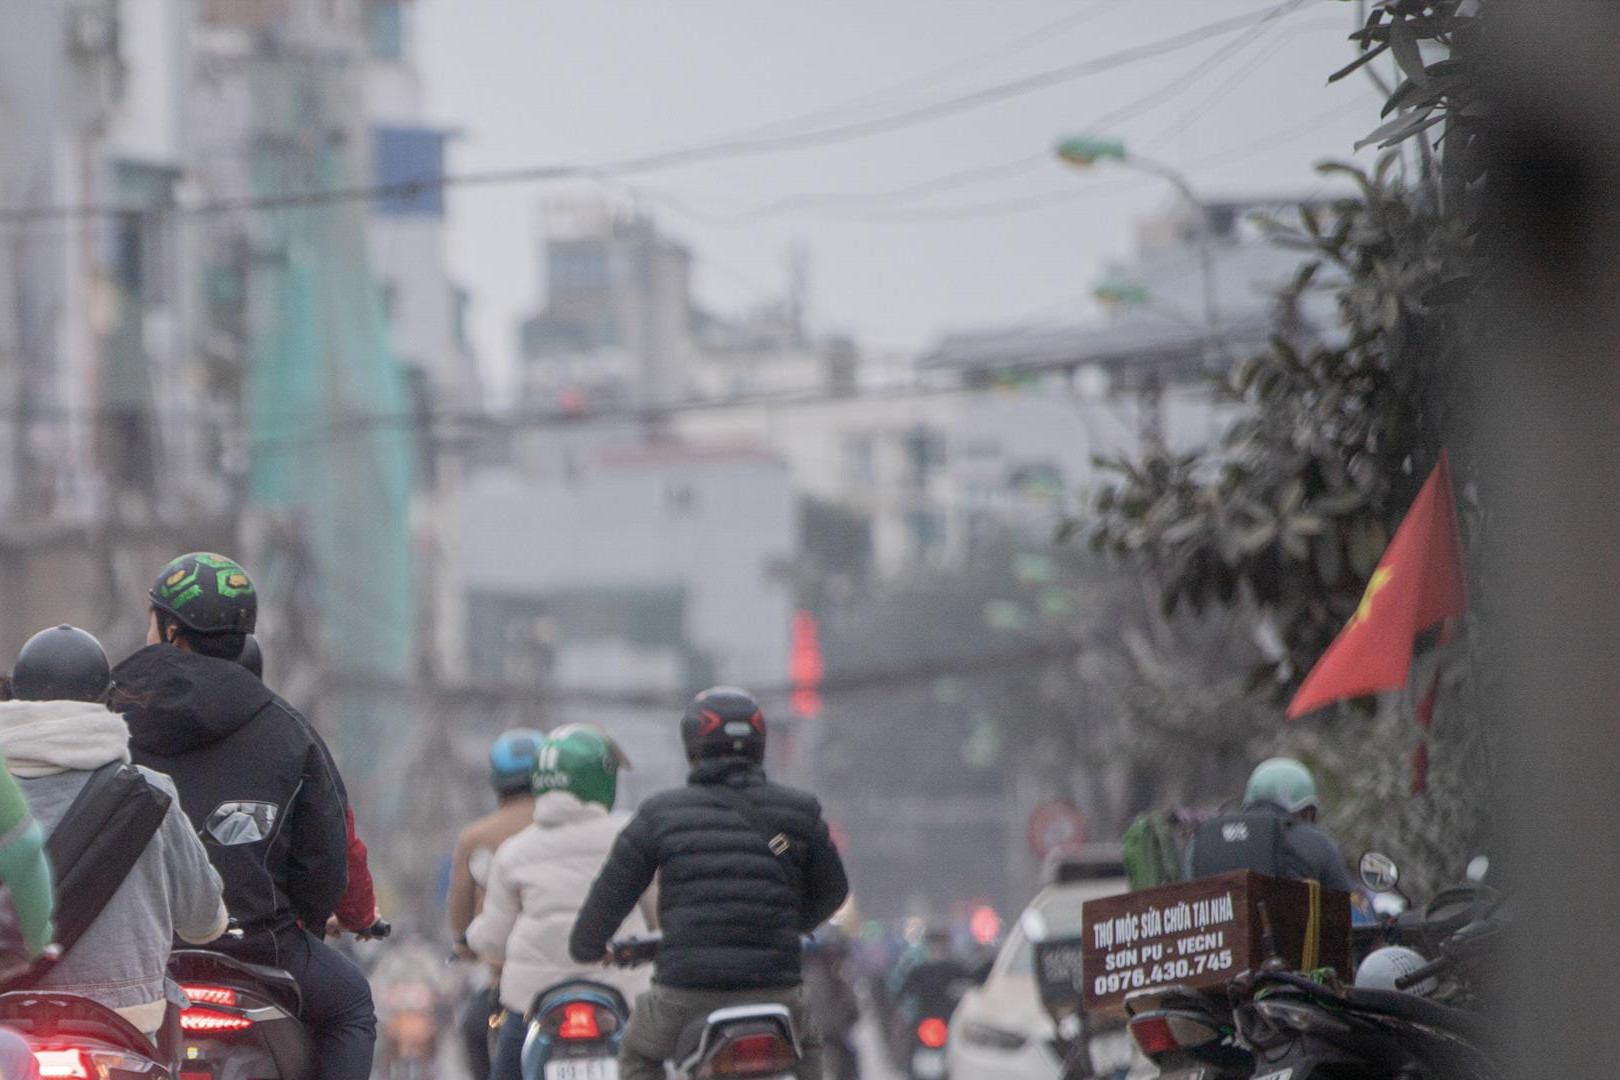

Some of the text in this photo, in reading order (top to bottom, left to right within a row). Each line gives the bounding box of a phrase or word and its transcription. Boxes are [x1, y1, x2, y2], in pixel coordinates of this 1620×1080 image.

[1093, 918, 1114, 952] THỢ
[1115, 912, 1139, 947] MỘC
[1192, 899, 1210, 932] TẠI
[1094, 950, 1232, 995] 0976.430.745
[1105, 948, 1138, 971] SƠN
[1141, 943, 1163, 963] PU
